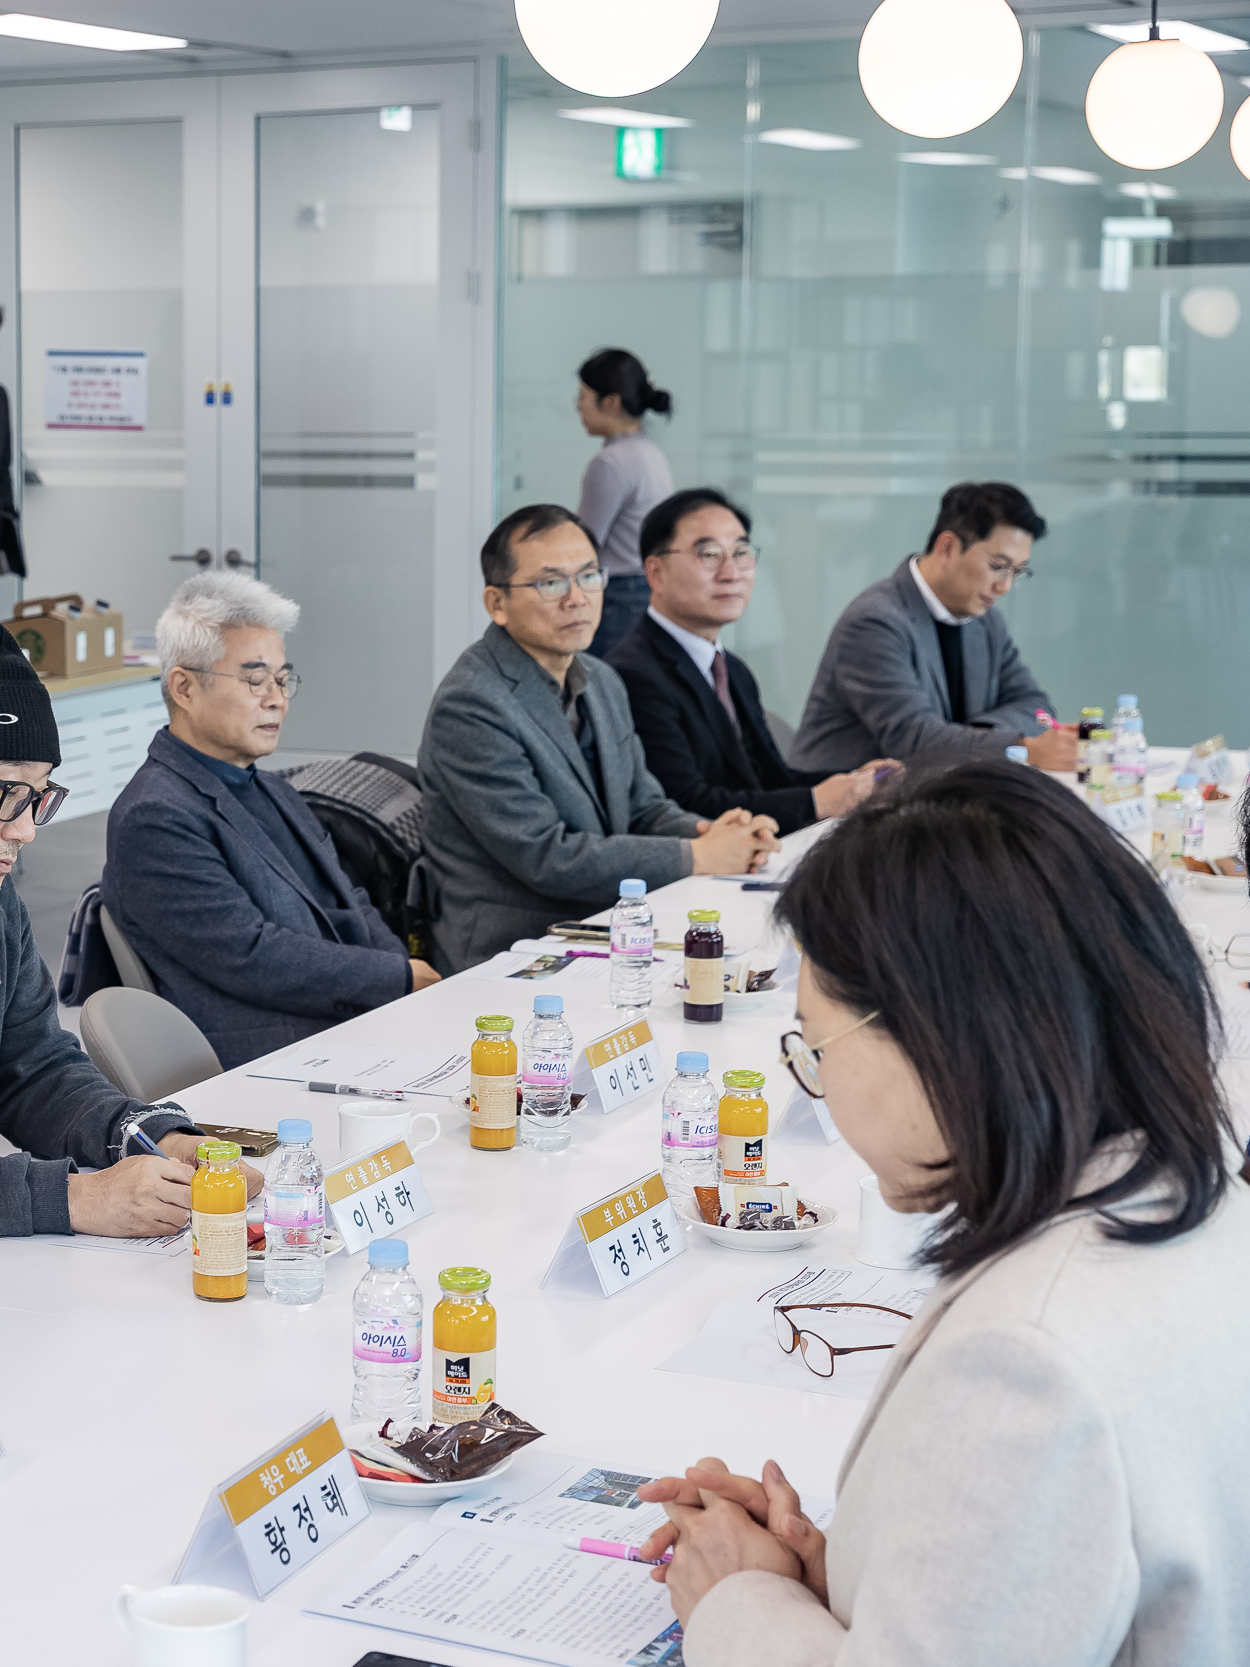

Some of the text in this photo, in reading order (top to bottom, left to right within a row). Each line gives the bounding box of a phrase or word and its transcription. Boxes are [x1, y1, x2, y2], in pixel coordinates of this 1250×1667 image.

[604, 1031, 637, 1059] 연출감독
[533, 1062, 567, 1073] 아이시스
[610, 1053, 654, 1097] 이선민
[345, 1155, 392, 1191] 연출감독
[353, 1180, 415, 1234] 이성하
[603, 1187, 648, 1227] 부위원장
[608, 1218, 670, 1277] 정치훈
[361, 1332, 407, 1348] 아이시스
[391, 1347, 407, 1358] 8.0
[445, 1384, 471, 1396] 오렌지
[259, 1448, 312, 1496] 청우 대표
